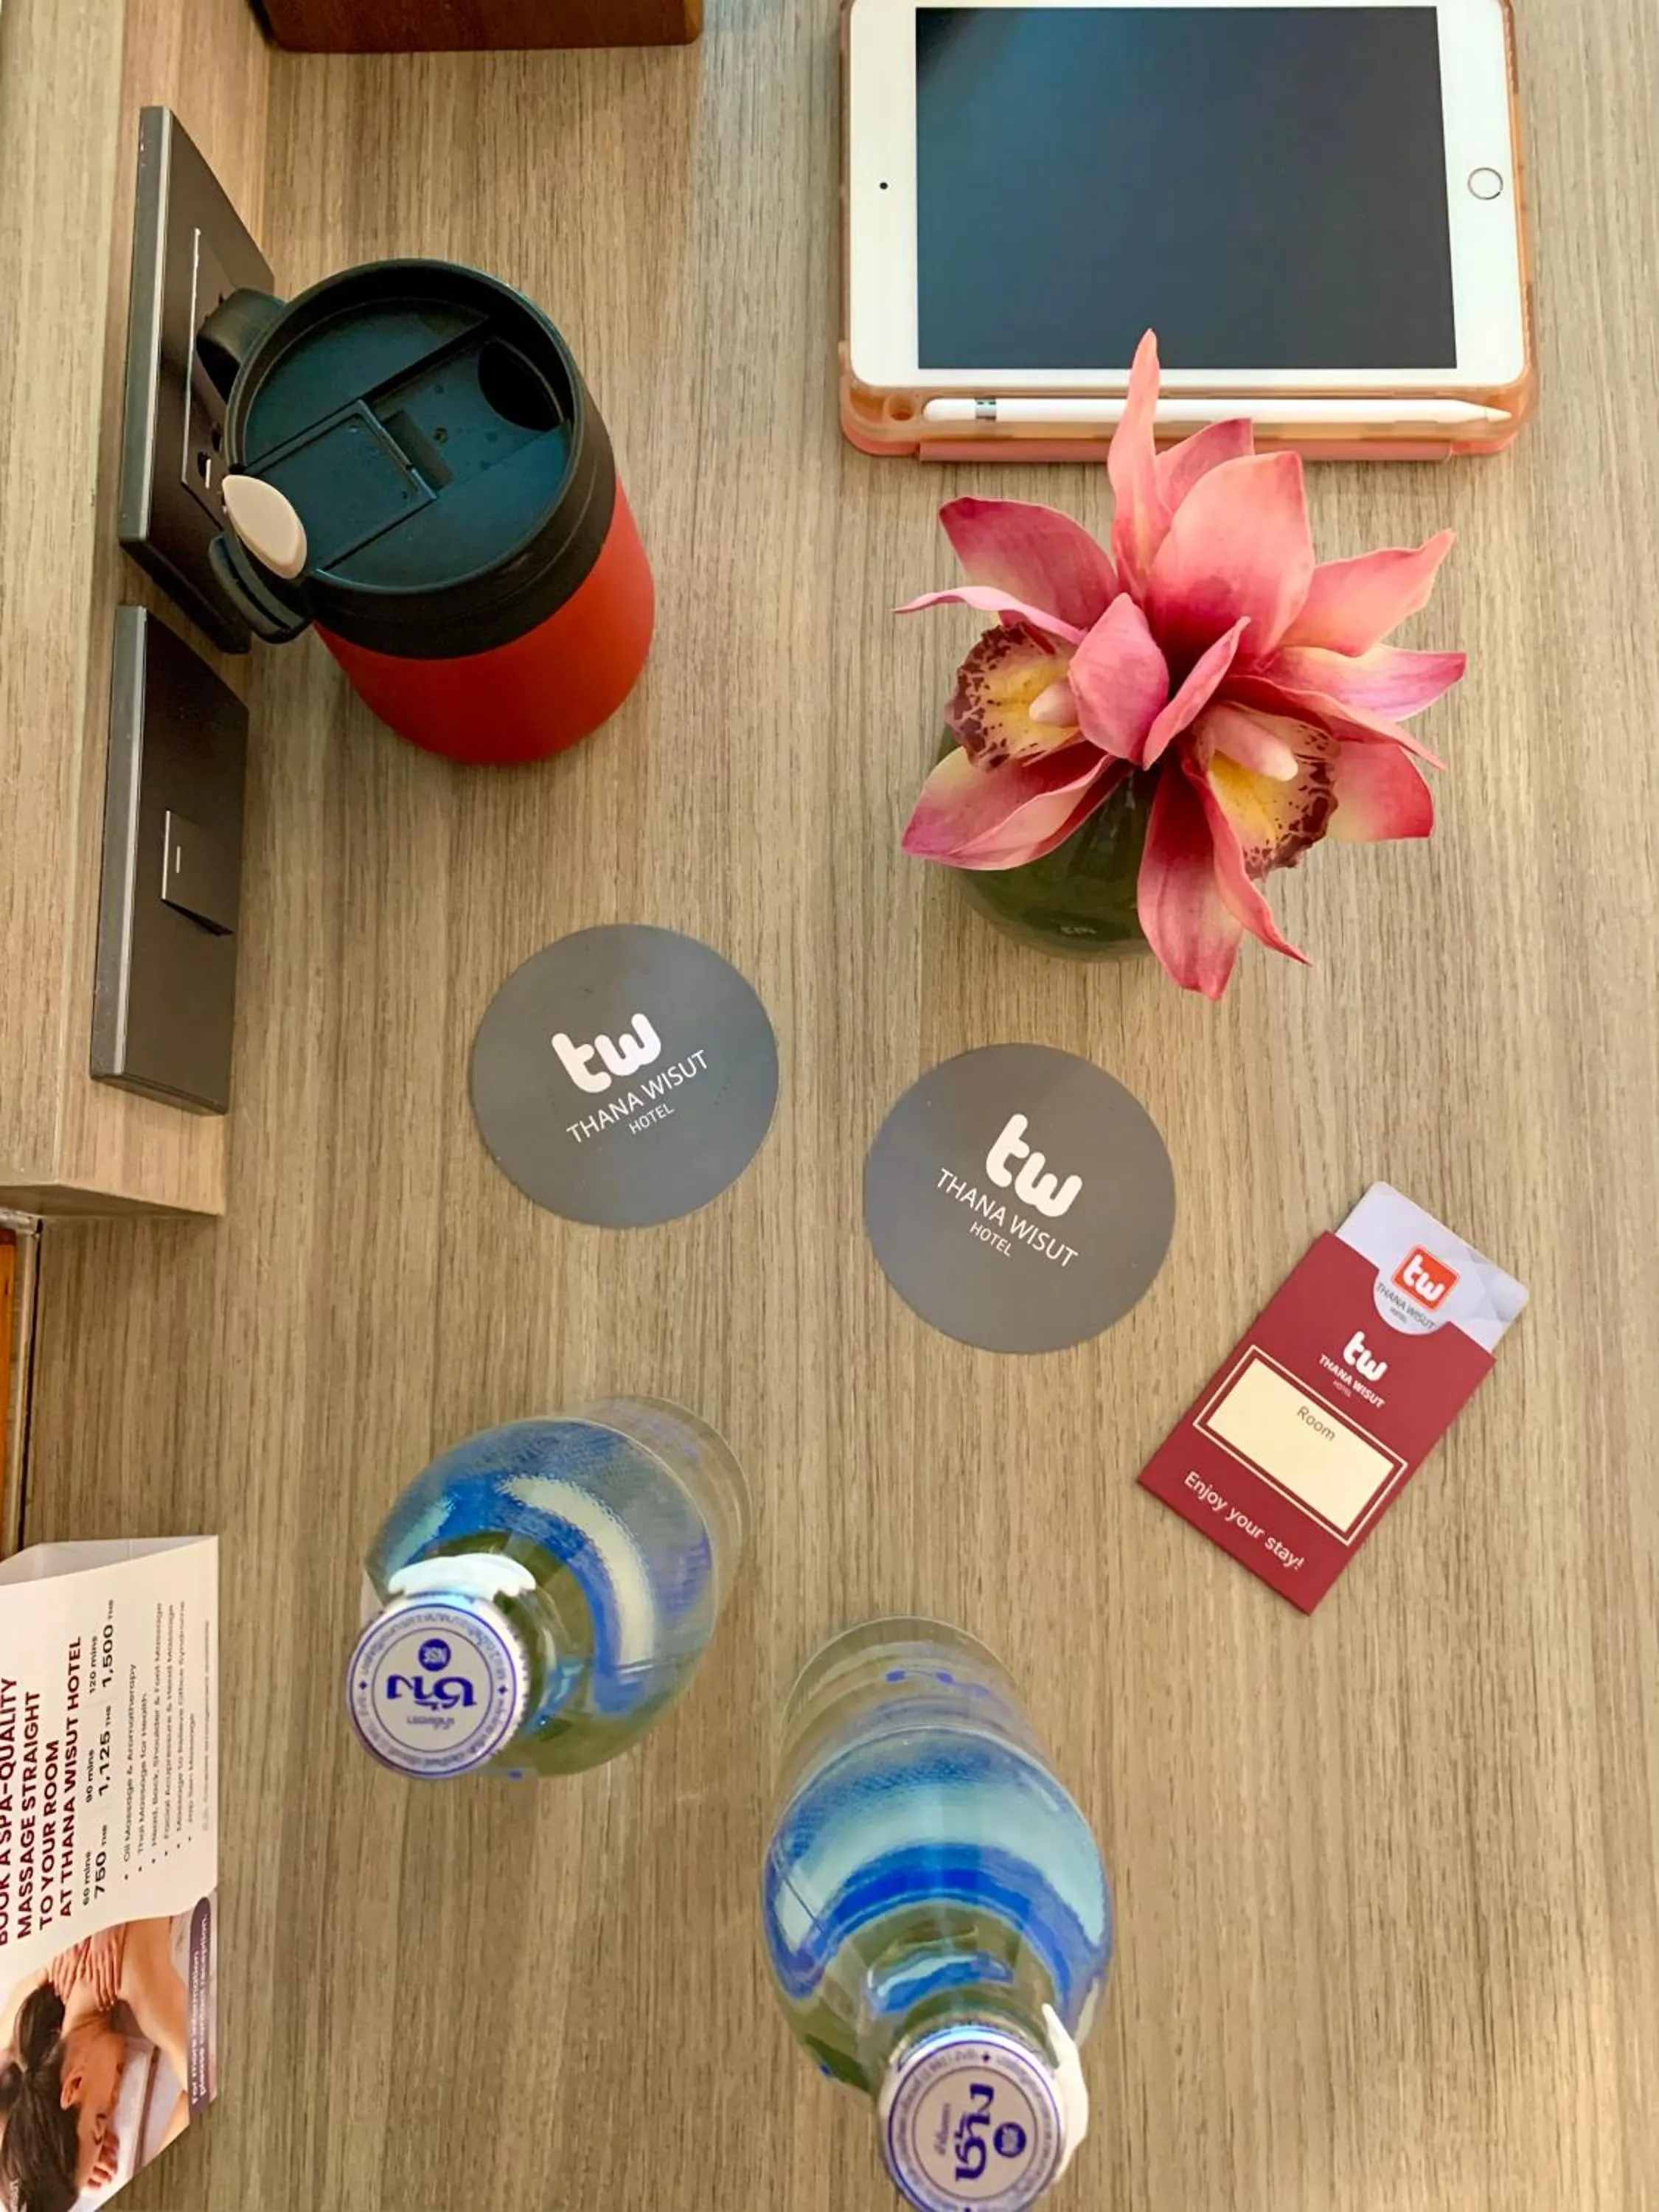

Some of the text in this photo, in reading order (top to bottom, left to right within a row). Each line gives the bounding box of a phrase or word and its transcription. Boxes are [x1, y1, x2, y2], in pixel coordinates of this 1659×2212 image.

[552, 1013, 661, 1093] tw
[566, 1049, 708, 1142] THANA WISUT
[628, 1102, 675, 1135] HOTEL
[986, 1113, 1082, 1217] tw
[935, 1167, 1079, 1267] THANA WISUT
[970, 1221, 1012, 1256] HOTEL
[1377, 1281, 1435, 1329] THANA WISUT
[1403, 1254, 1445, 1301] tw
[1318, 1353, 1385, 1408] THANA WISUT
[1343, 1331, 1388, 1381] tw
[1296, 1405, 1335, 1441] Room
[1183, 1471, 1305, 1571] Enjoy your stay!
[88, 1672, 97, 1694] 120
[102, 1625, 114, 1688] 1,500
[128, 1663, 136, 1761] Aromatherapy
[386, 1673, 478, 1711] ช้าง
[0, 1678, 16, 1843] SPA-QUALITY
[60, 1636, 81, 1916] AT THANA WISUT HOTEL
[86, 1749, 95, 1782] mins
[18, 1691, 40, 1939] MASSAGE STRAIGHT
[125, 1778, 133, 1841] Massage
[139, 1761, 147, 1823] Massage
[40, 1740, 59, 1930] TO YOUR ROOM
[83, 1851, 91, 1885] mins
[94, 1852, 107, 1900] 750
[953, 2083, 995, 2183] ช้าง
